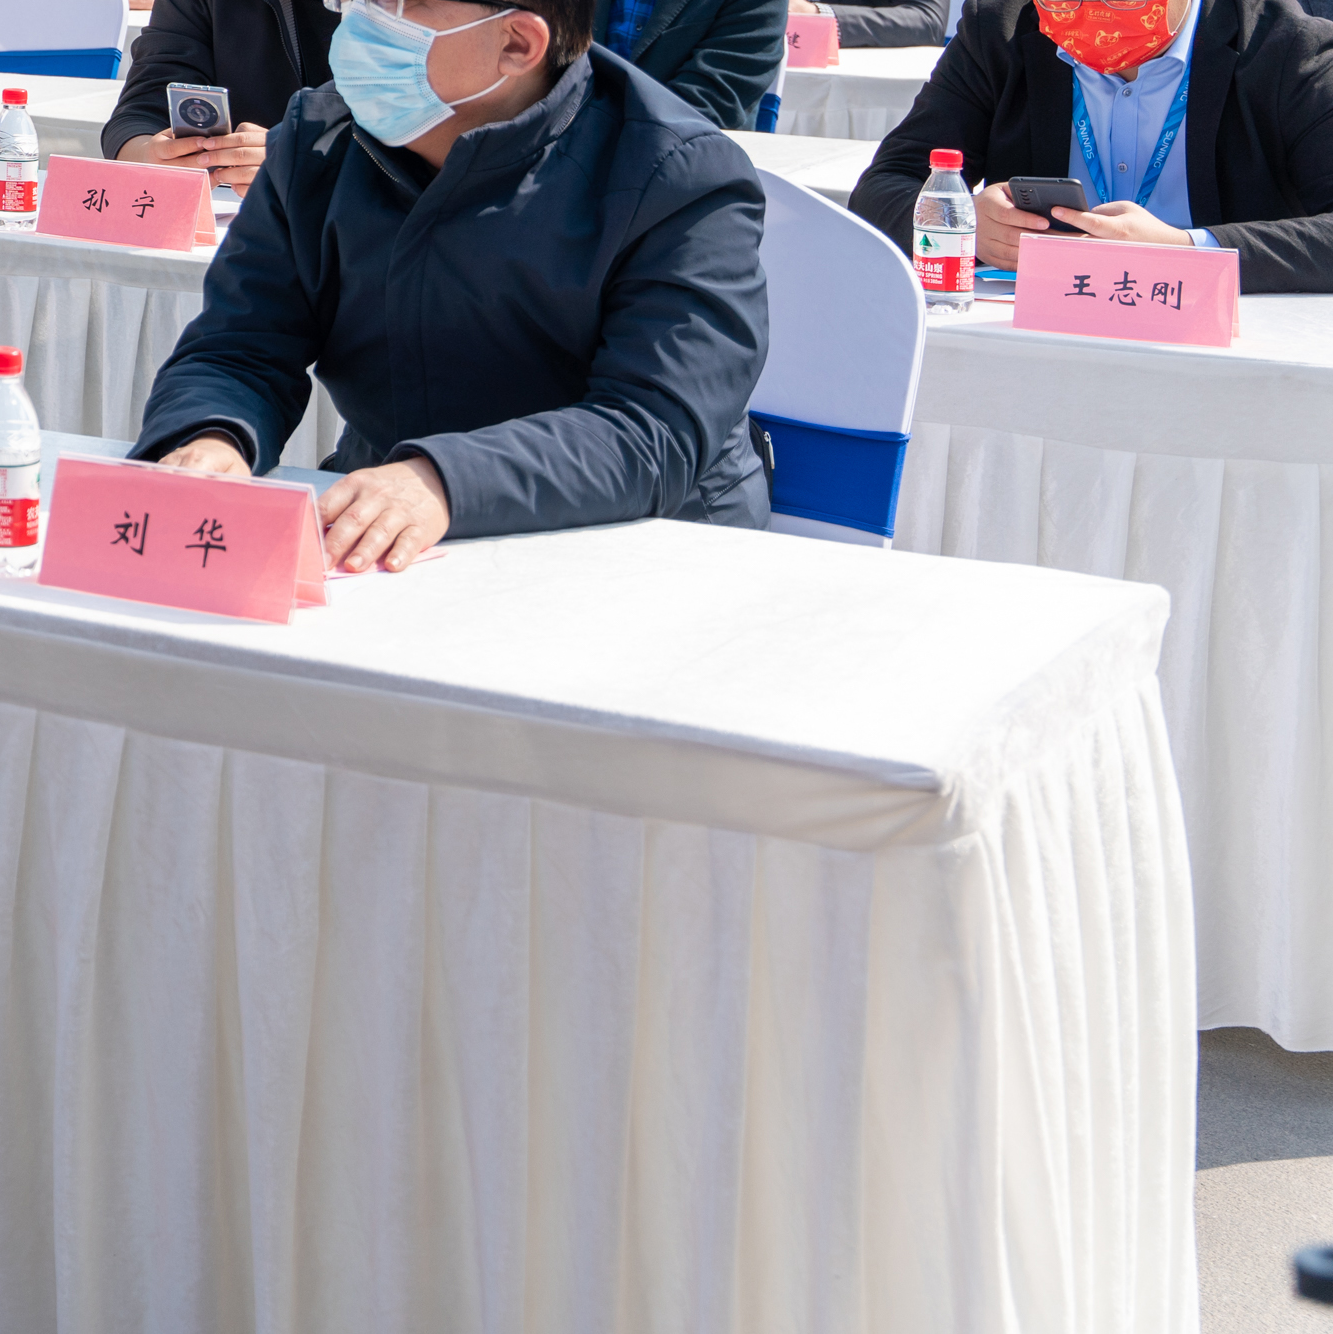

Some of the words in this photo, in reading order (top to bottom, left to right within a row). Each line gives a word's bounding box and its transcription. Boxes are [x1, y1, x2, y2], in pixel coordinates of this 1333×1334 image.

[1077, 120, 1095, 160] SUNING
[1154, 130, 1174, 169] SUNING
[81, 188, 155, 220] 孙宁
[1064, 270, 1184, 312] 王志刚
[110, 512, 228, 569] 刘华
